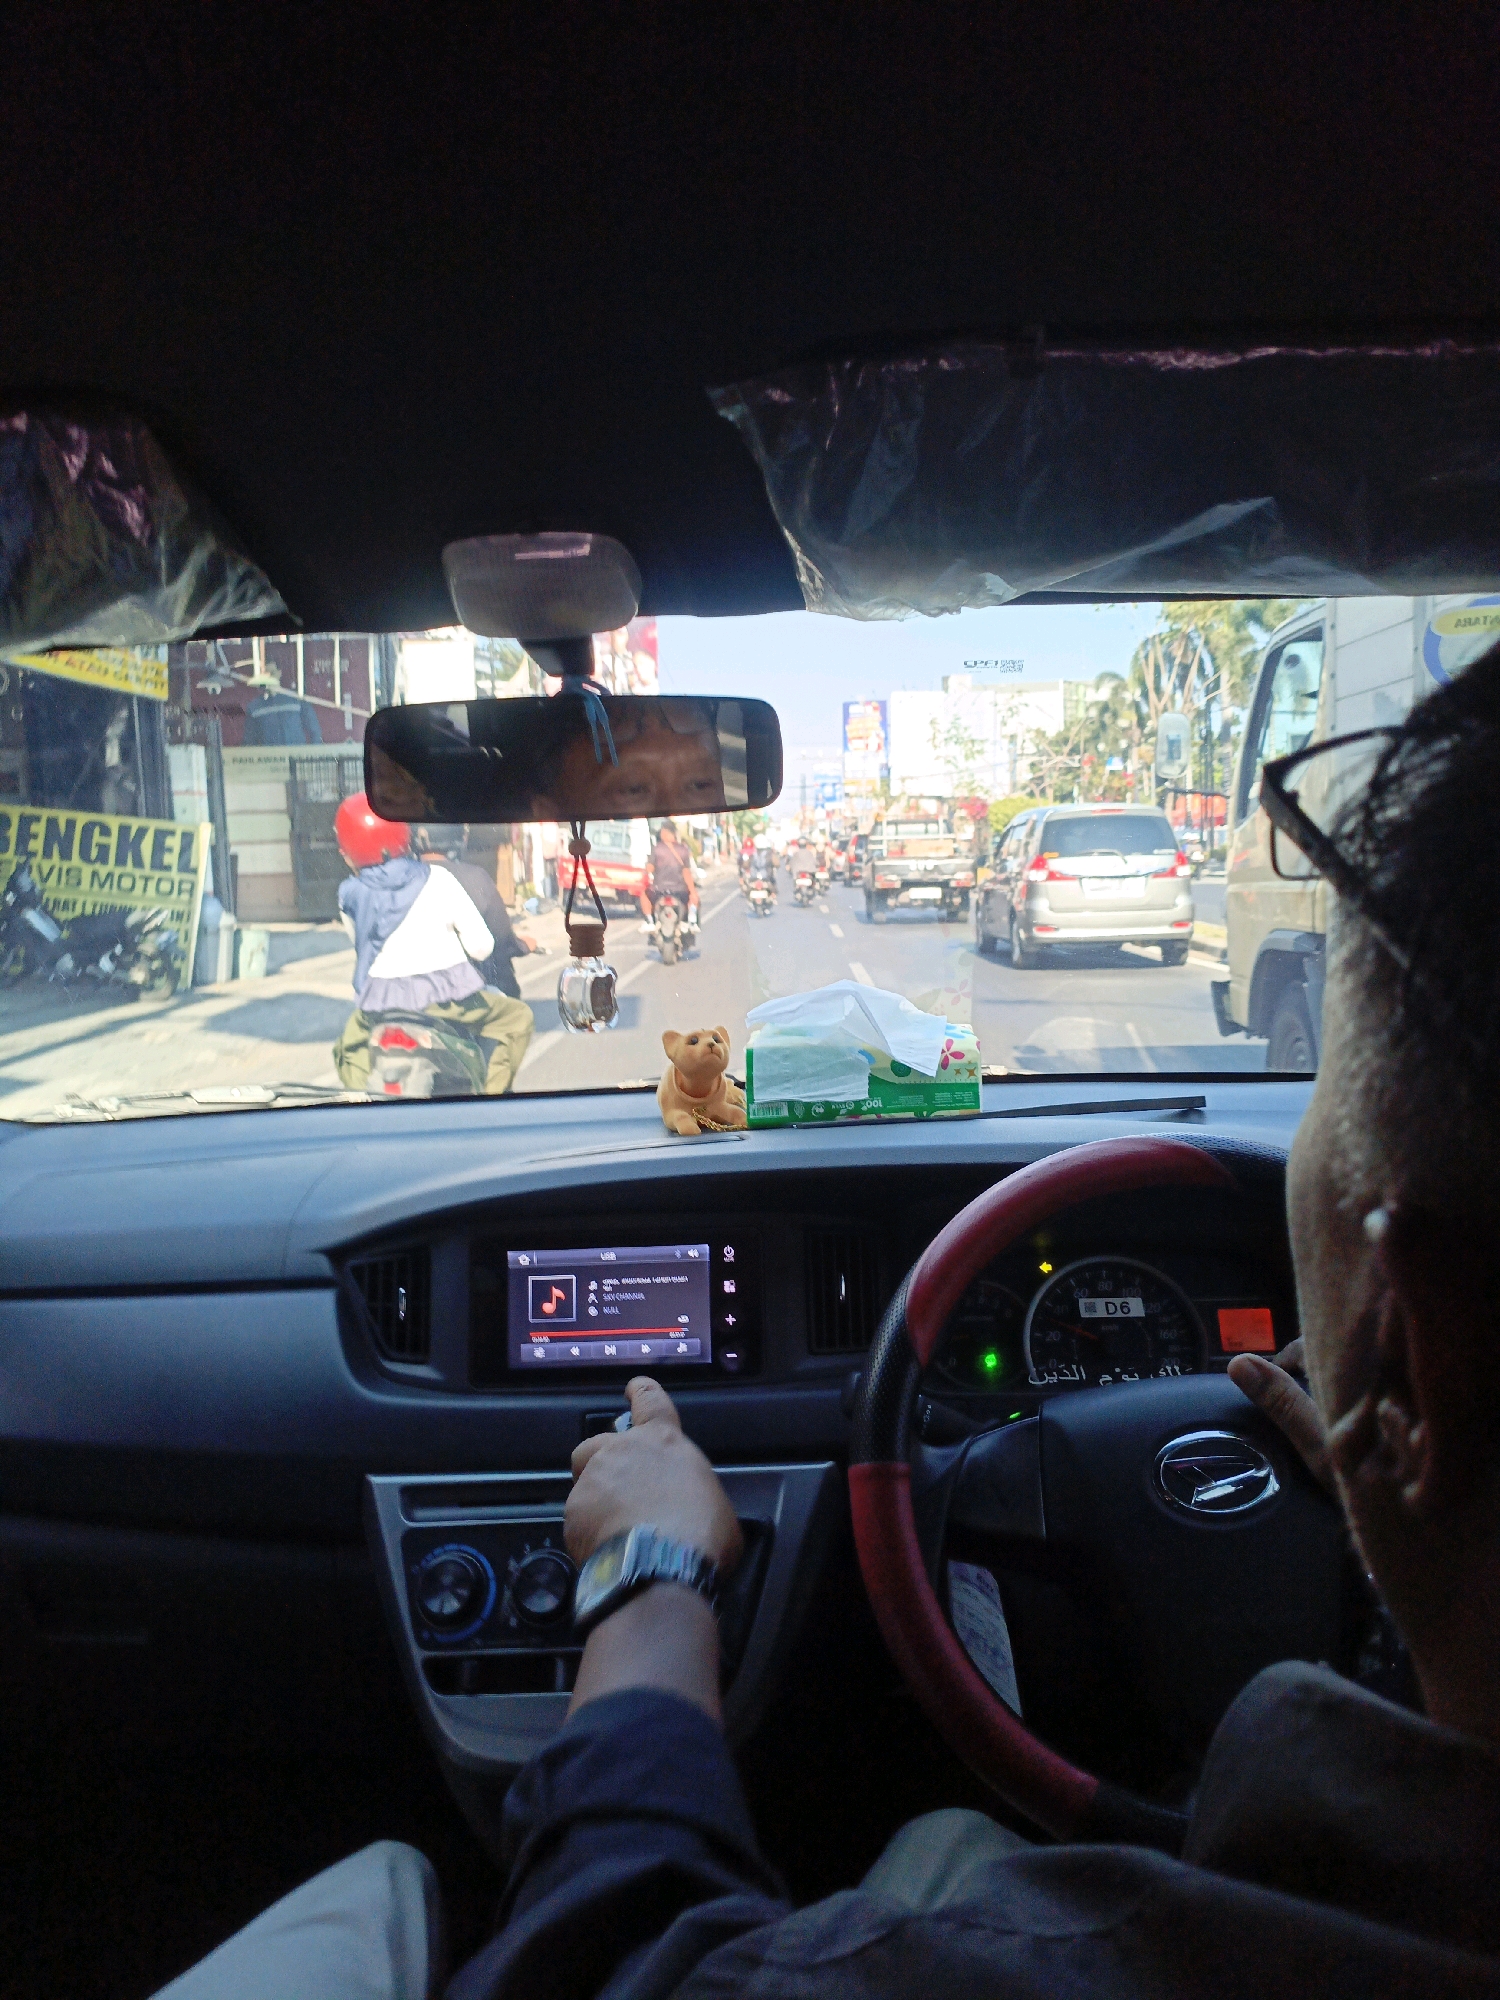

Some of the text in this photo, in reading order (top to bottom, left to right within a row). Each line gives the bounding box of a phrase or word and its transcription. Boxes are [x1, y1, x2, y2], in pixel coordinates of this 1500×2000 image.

[90, 869, 195, 897] MOTOR
[600, 1251, 617, 1261] USB
[1073, 1287, 1089, 1298] 60
[1104, 1301, 1131, 1315] D6
[1045, 1331, 1061, 1342] 20
